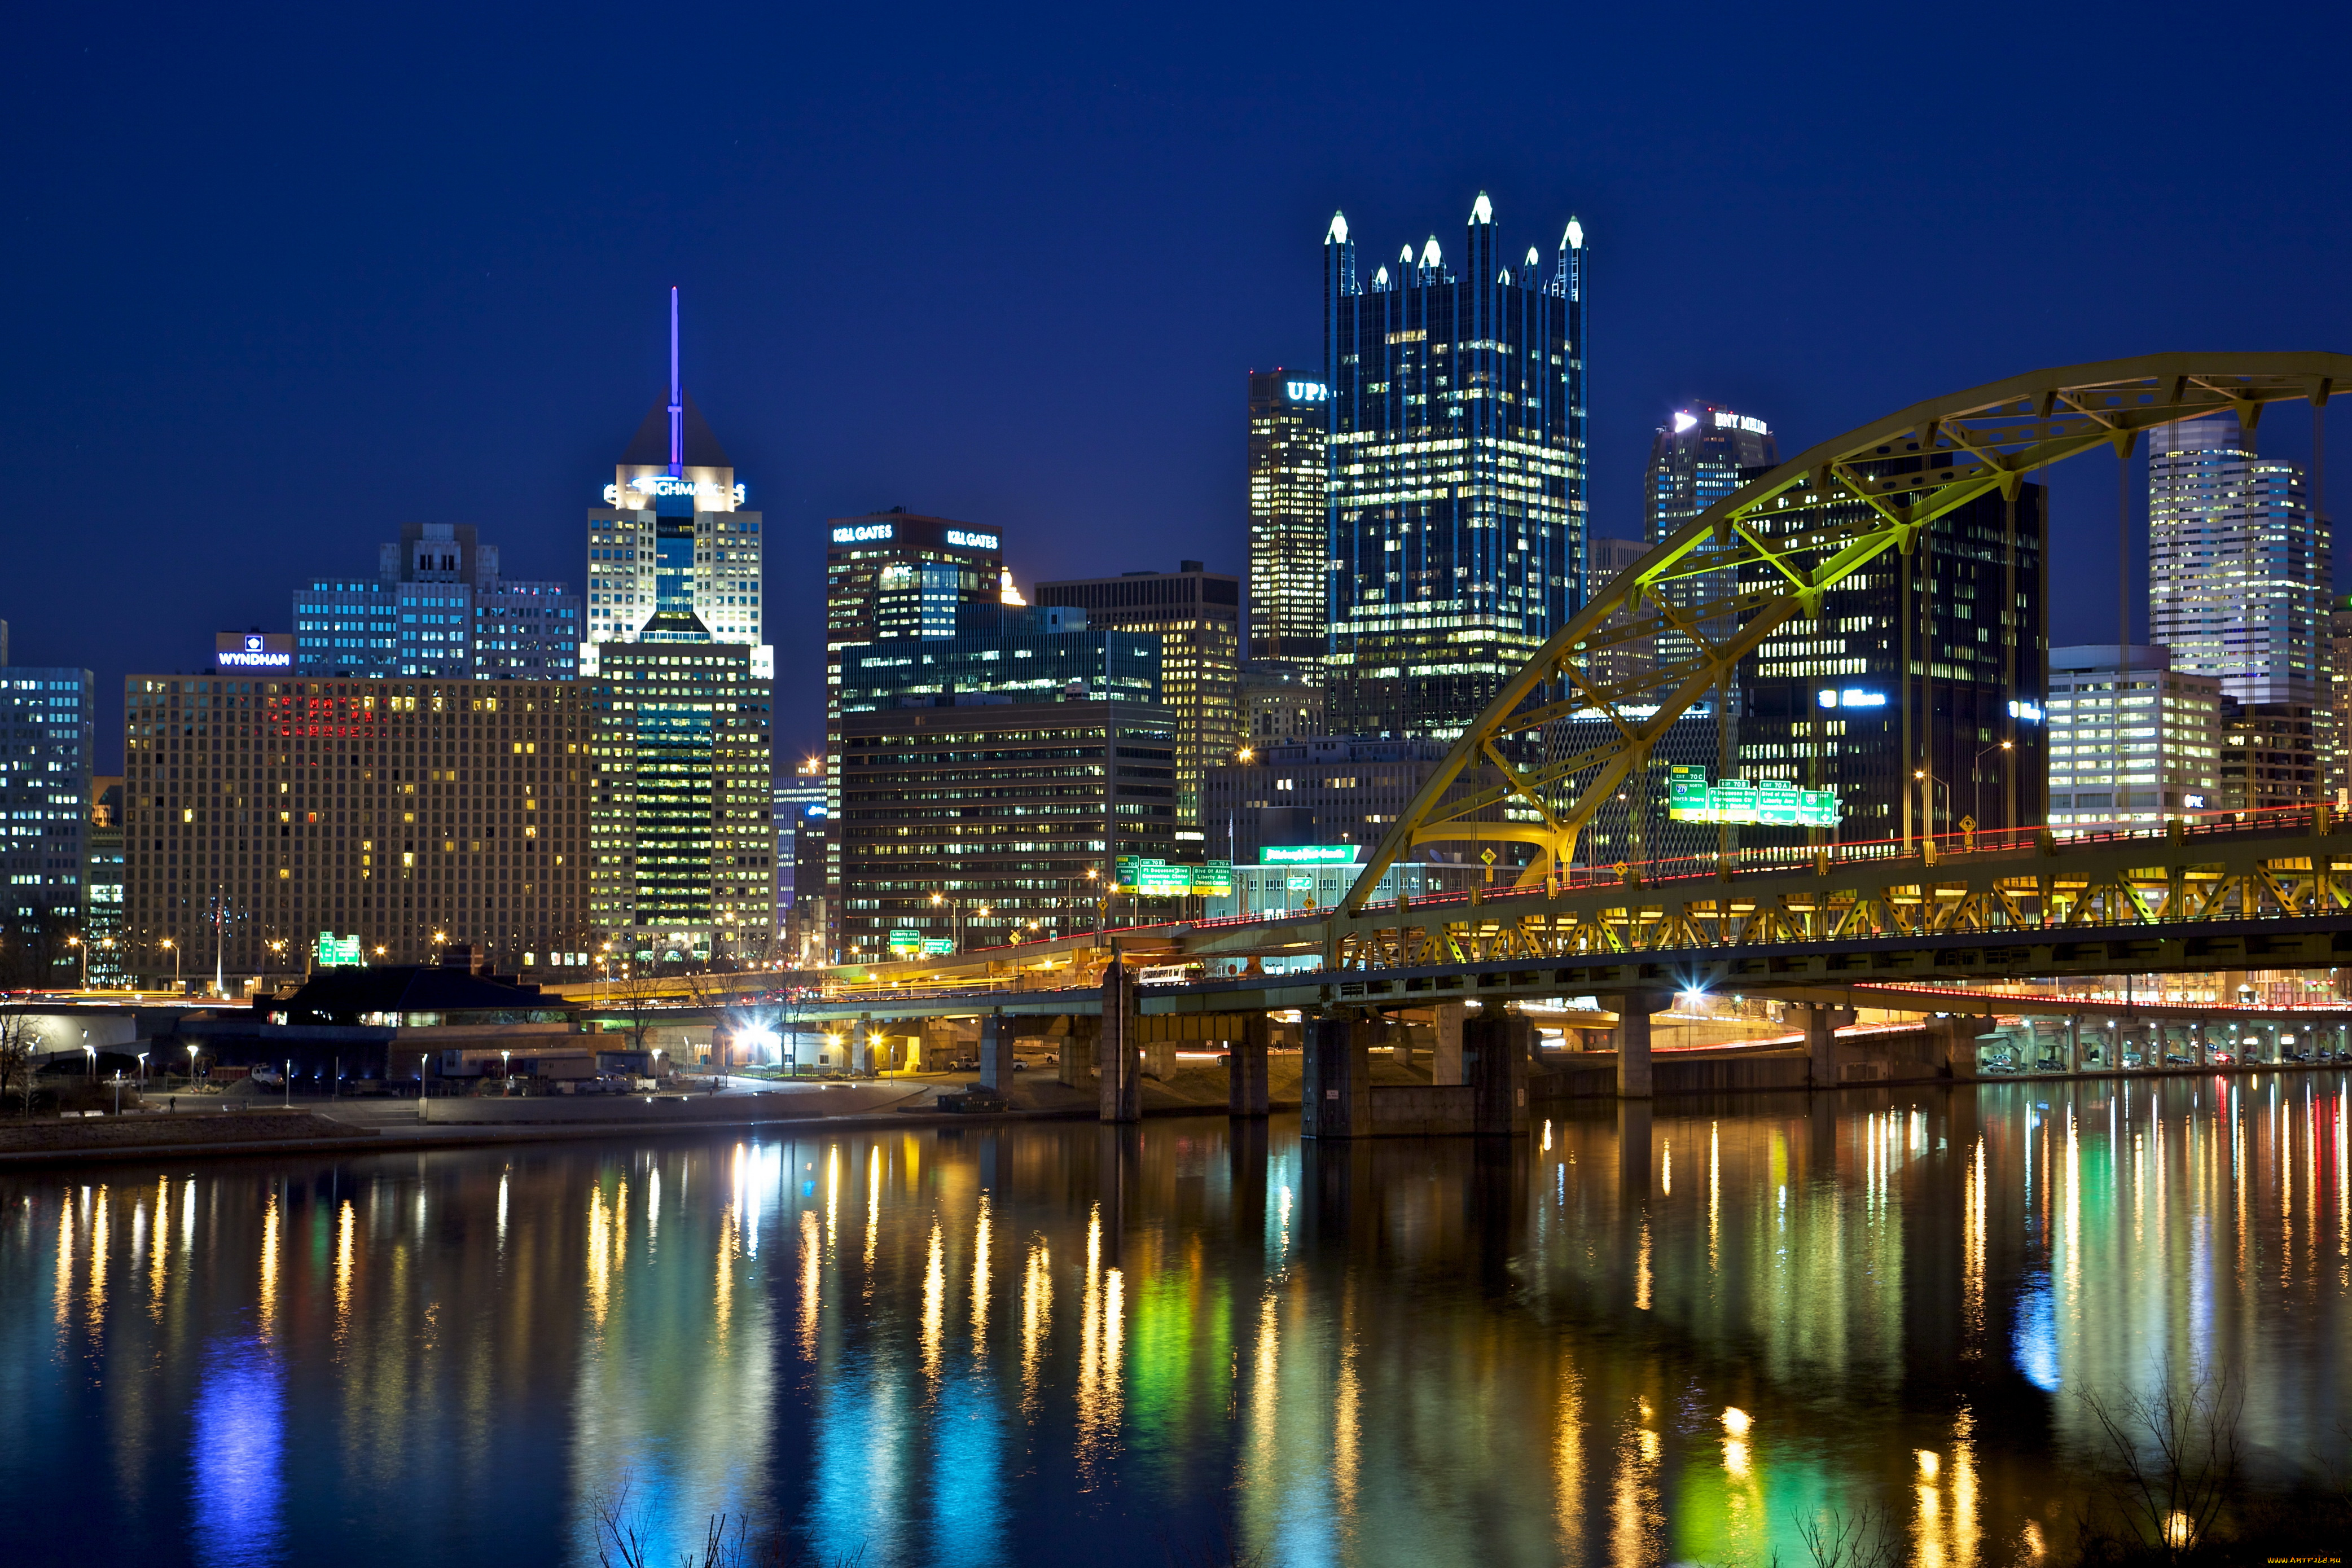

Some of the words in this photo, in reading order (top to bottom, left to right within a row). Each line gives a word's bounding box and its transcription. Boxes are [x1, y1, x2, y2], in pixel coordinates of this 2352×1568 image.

[1715, 412, 1739, 428] BNY
[641, 481, 719, 497] HIGHMARK
[833, 528, 855, 542] K&L
[855, 524, 892, 540] GATES
[948, 530, 966, 546] K&L
[967, 533, 998, 549] GATES
[893, 566, 912, 577] PNC
[219, 653, 289, 666] WYNDHAM
[1578, 707, 1614, 718] unite
